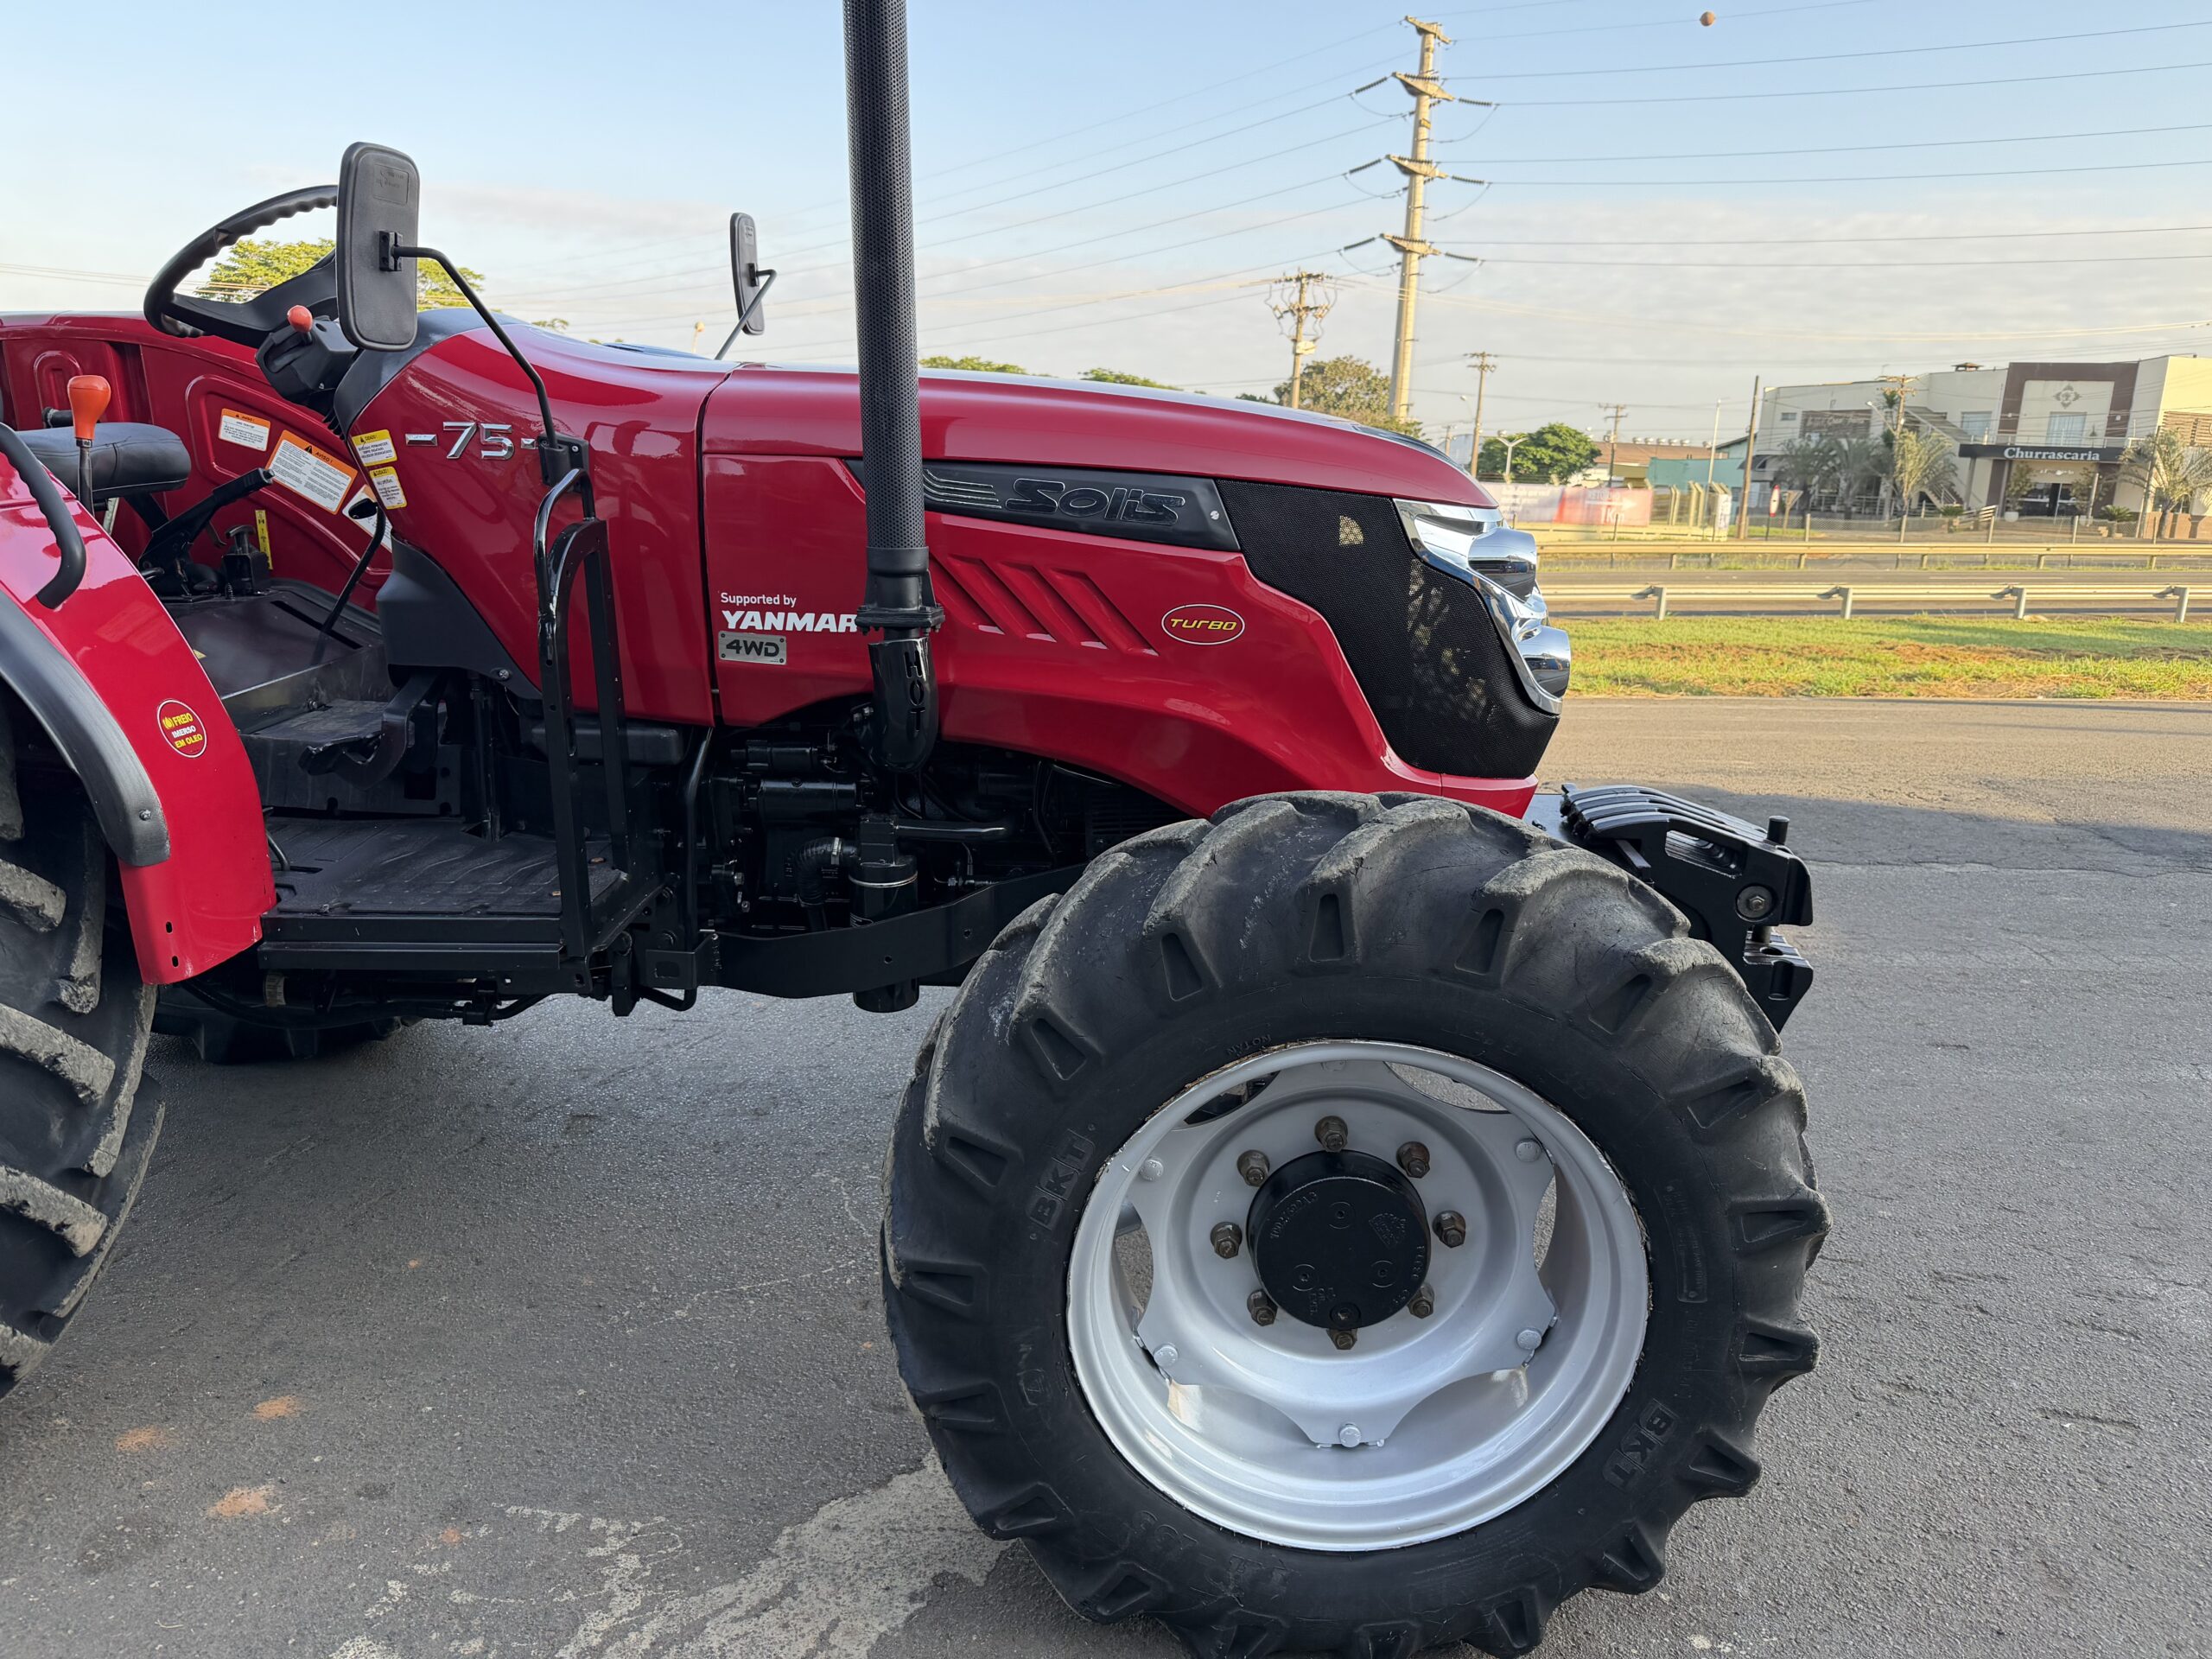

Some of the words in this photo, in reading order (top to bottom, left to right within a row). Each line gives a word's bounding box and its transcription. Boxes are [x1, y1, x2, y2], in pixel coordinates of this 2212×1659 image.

[315, 451, 330, 462] AVISO
[2004, 447, 2100, 461] Churrascaria
[721, 592, 780, 607] Supported
[783, 594, 797, 608] by
[721, 610, 858, 632] YANMAR
[726, 639, 779, 658] 4WD
[173, 713, 193, 726] FREIO
[172, 726, 196, 738] IMERSO
[175, 740, 186, 748] EM
[1029, 1128, 1094, 1230] BKT
[1604, 1398, 1679, 1488] BKT
